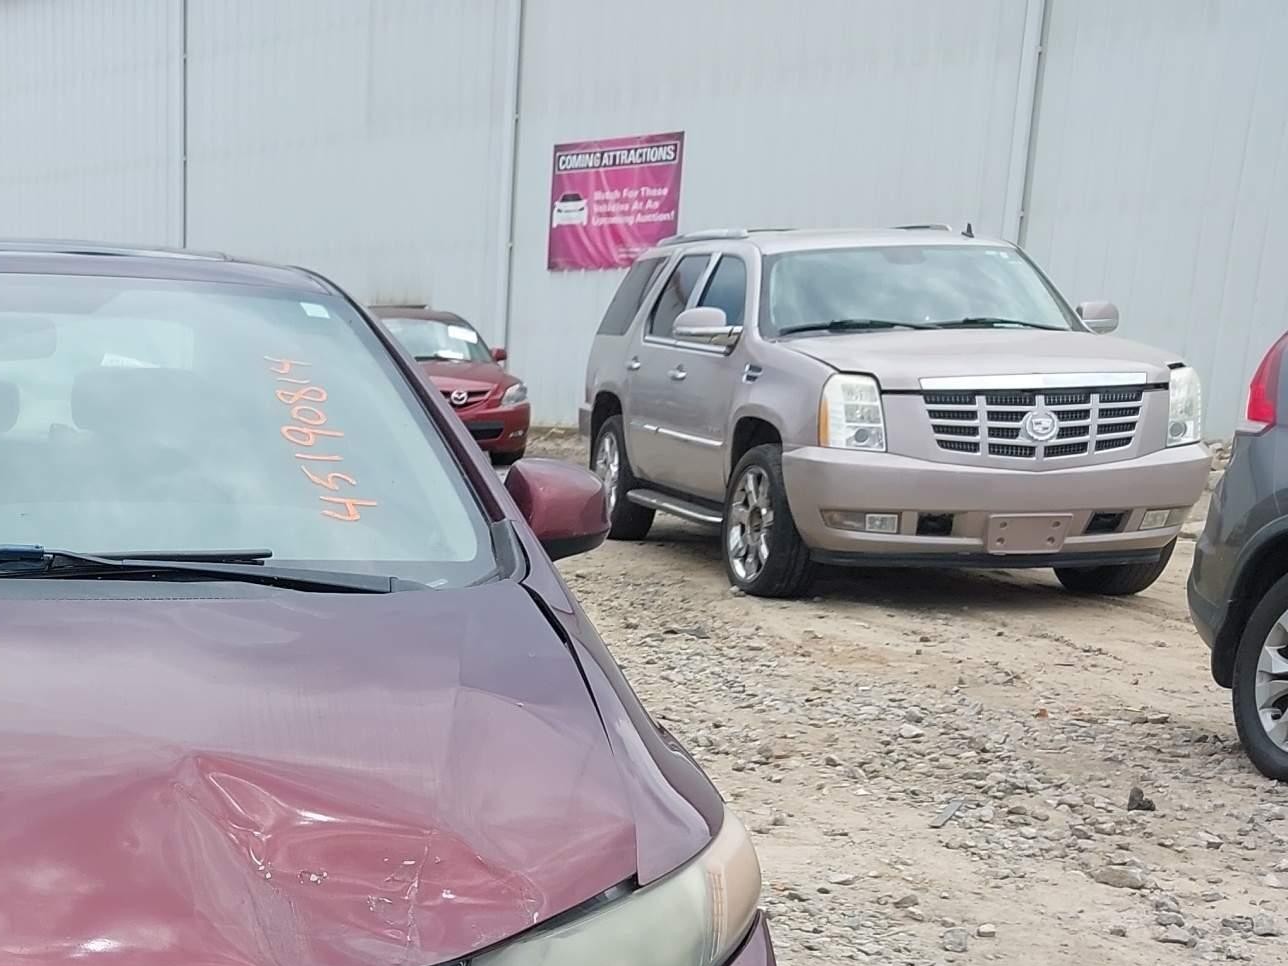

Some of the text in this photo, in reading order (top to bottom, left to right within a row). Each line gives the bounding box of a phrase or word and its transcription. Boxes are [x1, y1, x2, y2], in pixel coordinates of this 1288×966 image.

[558, 144, 676, 171] COMING ATTRACTIONS
[622, 186, 640, 199] For
[263, 354, 378, 522] 45190814
